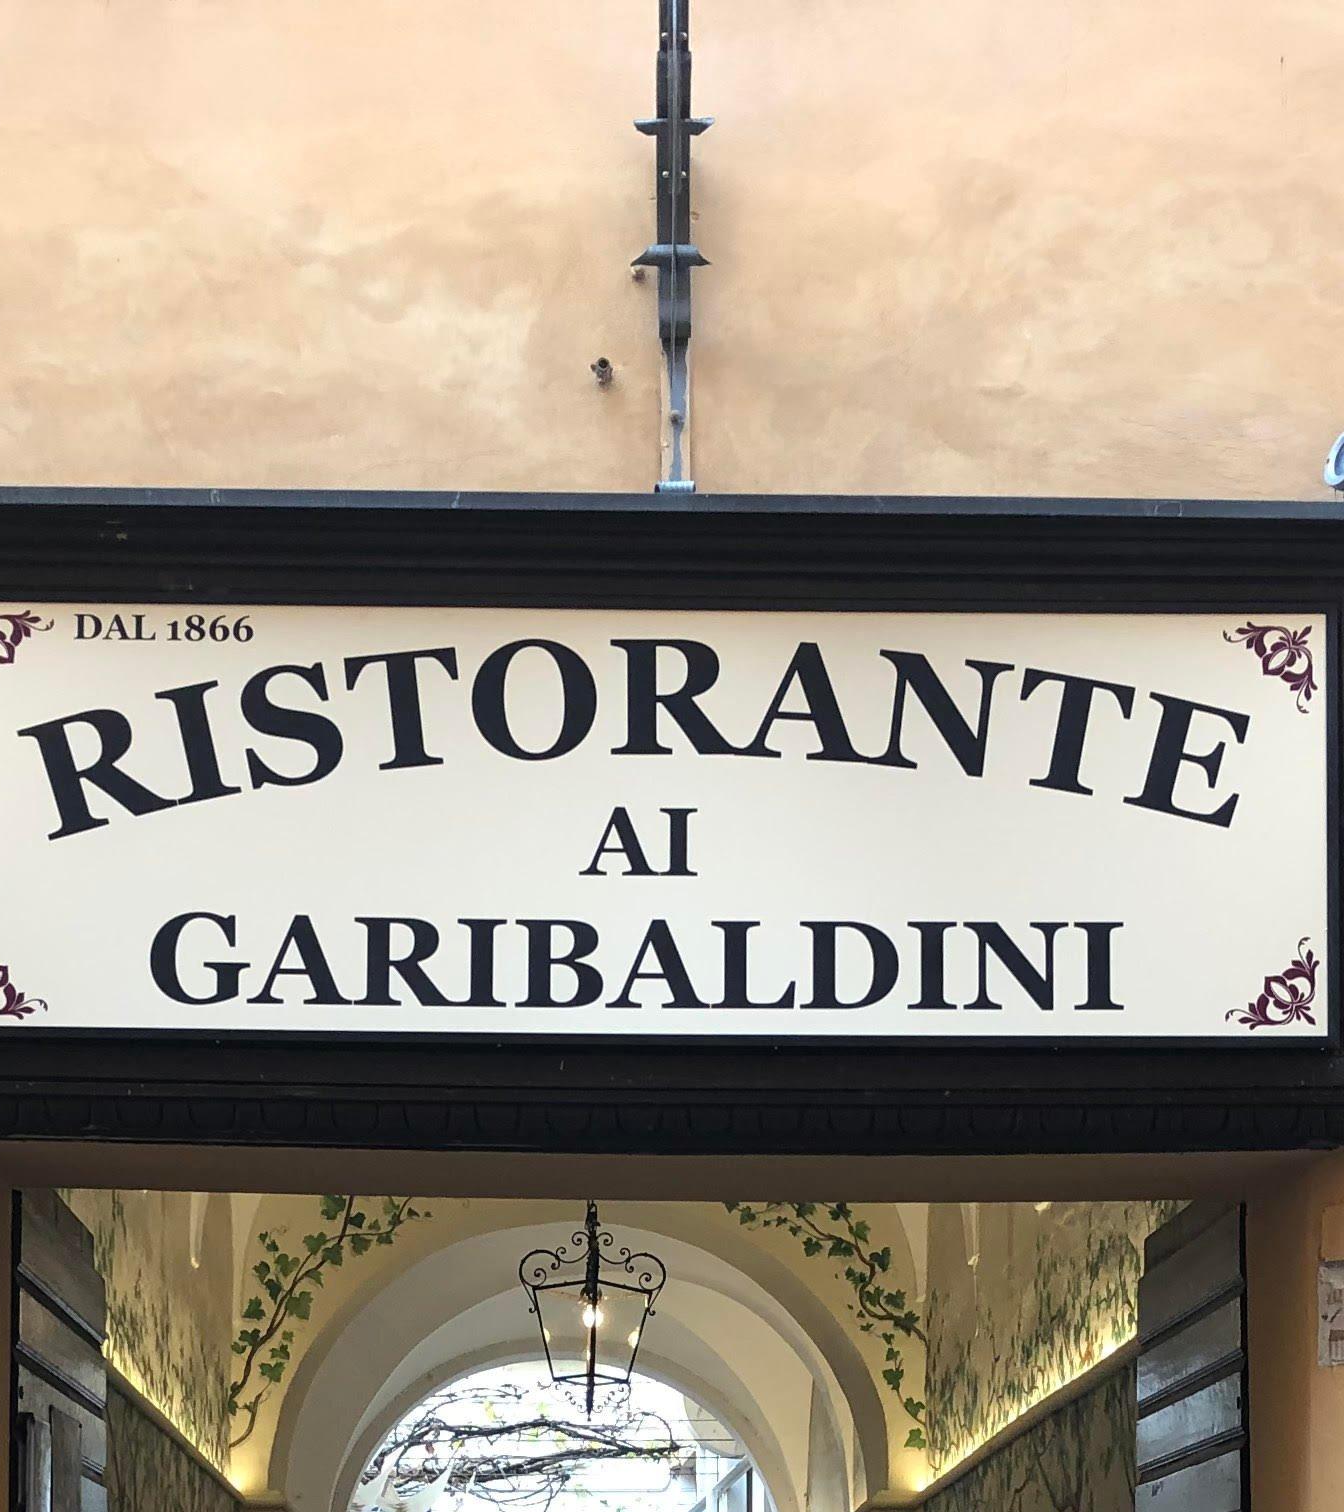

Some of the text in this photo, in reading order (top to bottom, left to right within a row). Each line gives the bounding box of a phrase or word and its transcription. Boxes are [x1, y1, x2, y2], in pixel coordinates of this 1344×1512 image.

[75, 613, 254, 642] DAL 1866
[18, 637, 1251, 839] RISTORANTE
[579, 807, 697, 877] AI
[149, 911, 1124, 1011] GARIBALDINI
